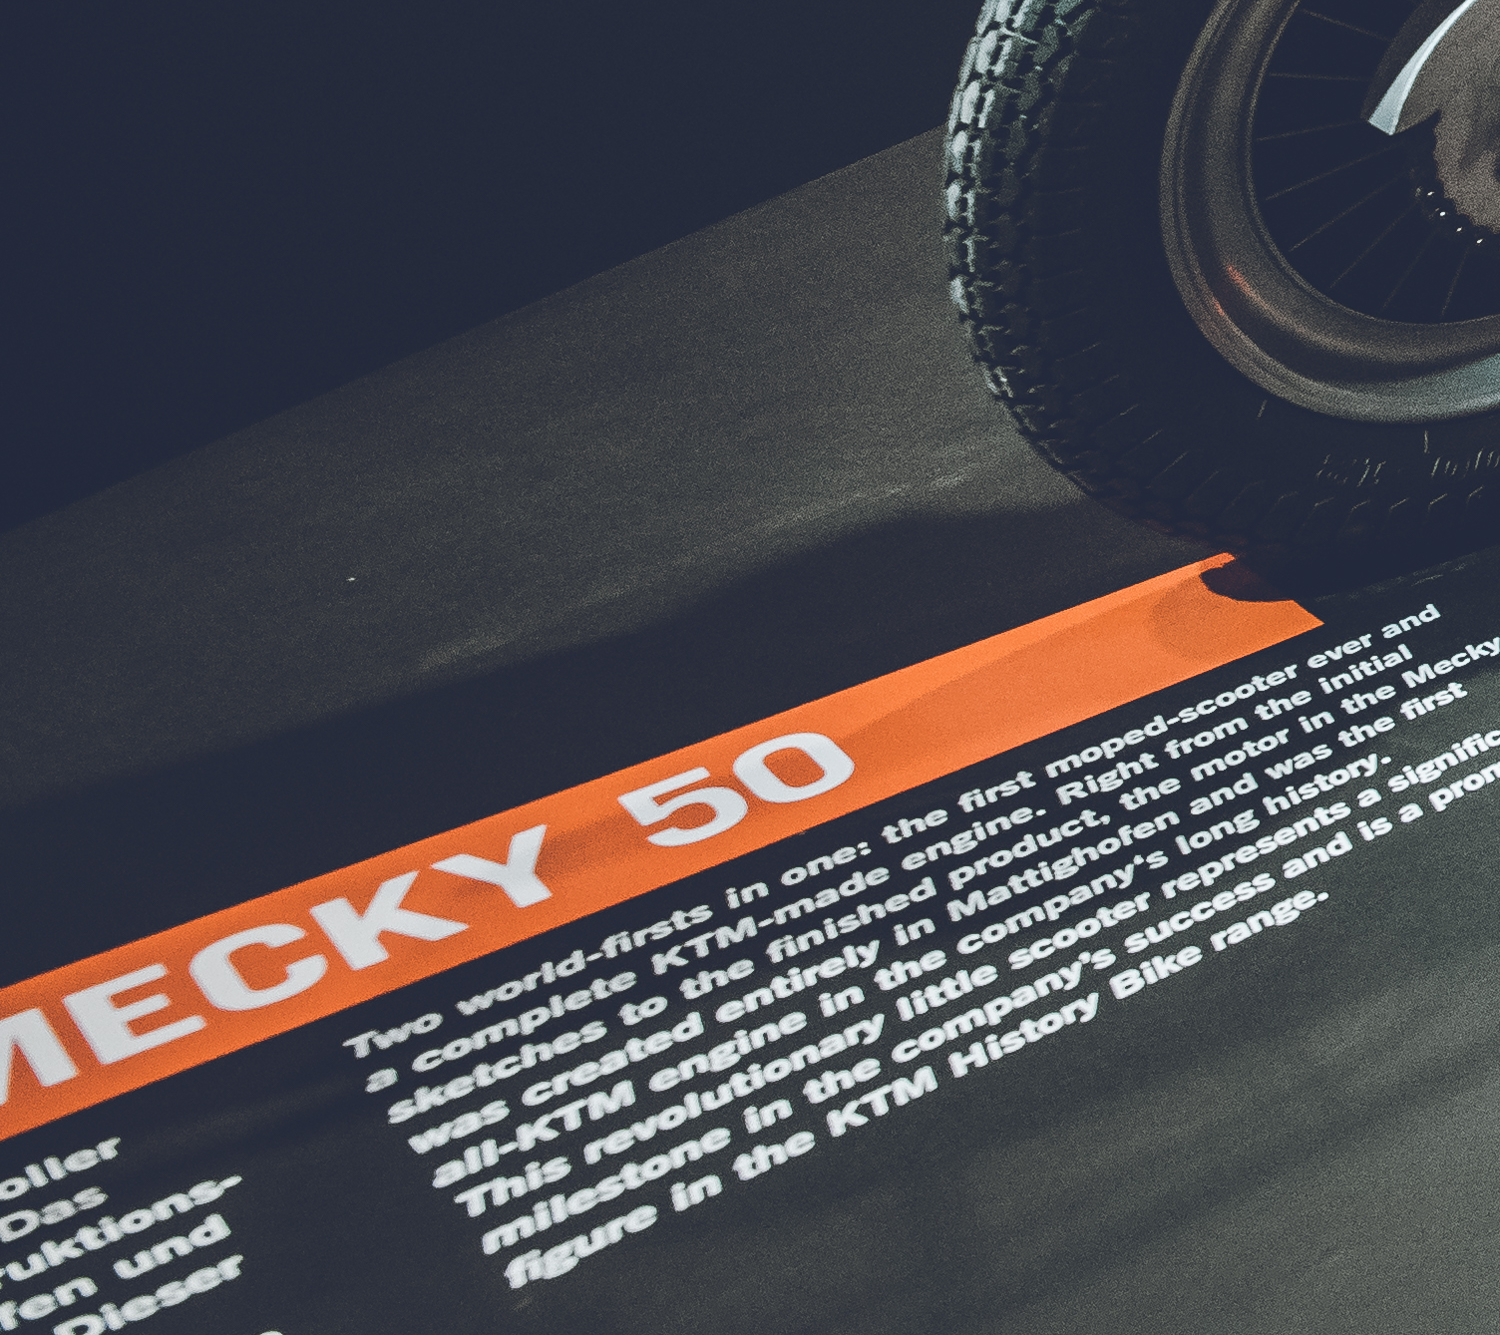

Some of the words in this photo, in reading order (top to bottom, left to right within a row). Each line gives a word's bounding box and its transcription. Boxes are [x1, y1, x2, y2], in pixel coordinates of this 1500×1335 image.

[341, 1012, 444, 1059] Two
[456, 903, 714, 1016] world-firsts
[725, 881, 770, 910] in
[779, 840, 873, 887] one:
[880, 808, 949, 845] the
[956, 770, 1038, 814] first
[1044, 663, 1299, 779] moped-scooter
[1306, 632, 1373, 670] ever
[1380, 602, 1442, 640] and
[365, 1067, 398, 1094] a
[410, 970, 637, 1073] complete
[650, 866, 890, 976] KTM-made
[900, 806, 1048, 872] engine.
[1054, 751, 1161, 806] Right
[1163, 716, 1250, 760] from
[1253, 689, 1313, 722] the
[1317, 642, 1414, 695] initial
[387, 1020, 608, 1125] sketches
[618, 995, 669, 1027] to
[678, 958, 756, 1001] the
[764, 875, 938, 965] finished
[947, 808, 1112, 892] product,
[1117, 777, 1182, 812] the
[1189, 727, 1290, 783] motor
[1297, 710, 1336, 734] in
[1339, 684, 1398, 716] the
[407, 1099, 511, 1155] was
[520, 1010, 705, 1107] created
[714, 939, 881, 1024] entirely
[892, 917, 937, 947] in
[945, 810, 1181, 923] Mattighofen
[1188, 771, 1260, 816] and
[1263, 743, 1334, 781] was
[1336, 715, 1397, 749] the
[1398, 681, 1469, 722] first
[431, 1079, 637, 1189] all-KTM
[647, 1010, 809, 1093] engine
[817, 985, 866, 1019] in
[872, 948, 948, 992] the
[1174, 808, 1261, 856] long
[1261, 752, 1393, 817] history.
[453, 1155, 573, 1219] This
[582, 1012, 886, 1166] revolutionary
[894, 964, 1000, 1023] little
[1007, 890, 1152, 971] scooter
[1160, 801, 1353, 900] represents
[1355, 787, 1383, 809] a
[618, 732, 855, 847] 50
[0, 1175, 243, 1282] uktions-
[53, 1254, 244, 1335] Dieser
[113, 1213, 232, 1280] und
[502, 1204, 658, 1290] figure
[669, 1174, 723, 1213] in
[731, 1130, 817, 1182] the
[825, 1064, 939, 1138] KTM
[947, 991, 1100, 1079] History
[1107, 944, 1204, 1001] Bike
[1208, 889, 1330, 953] range.
